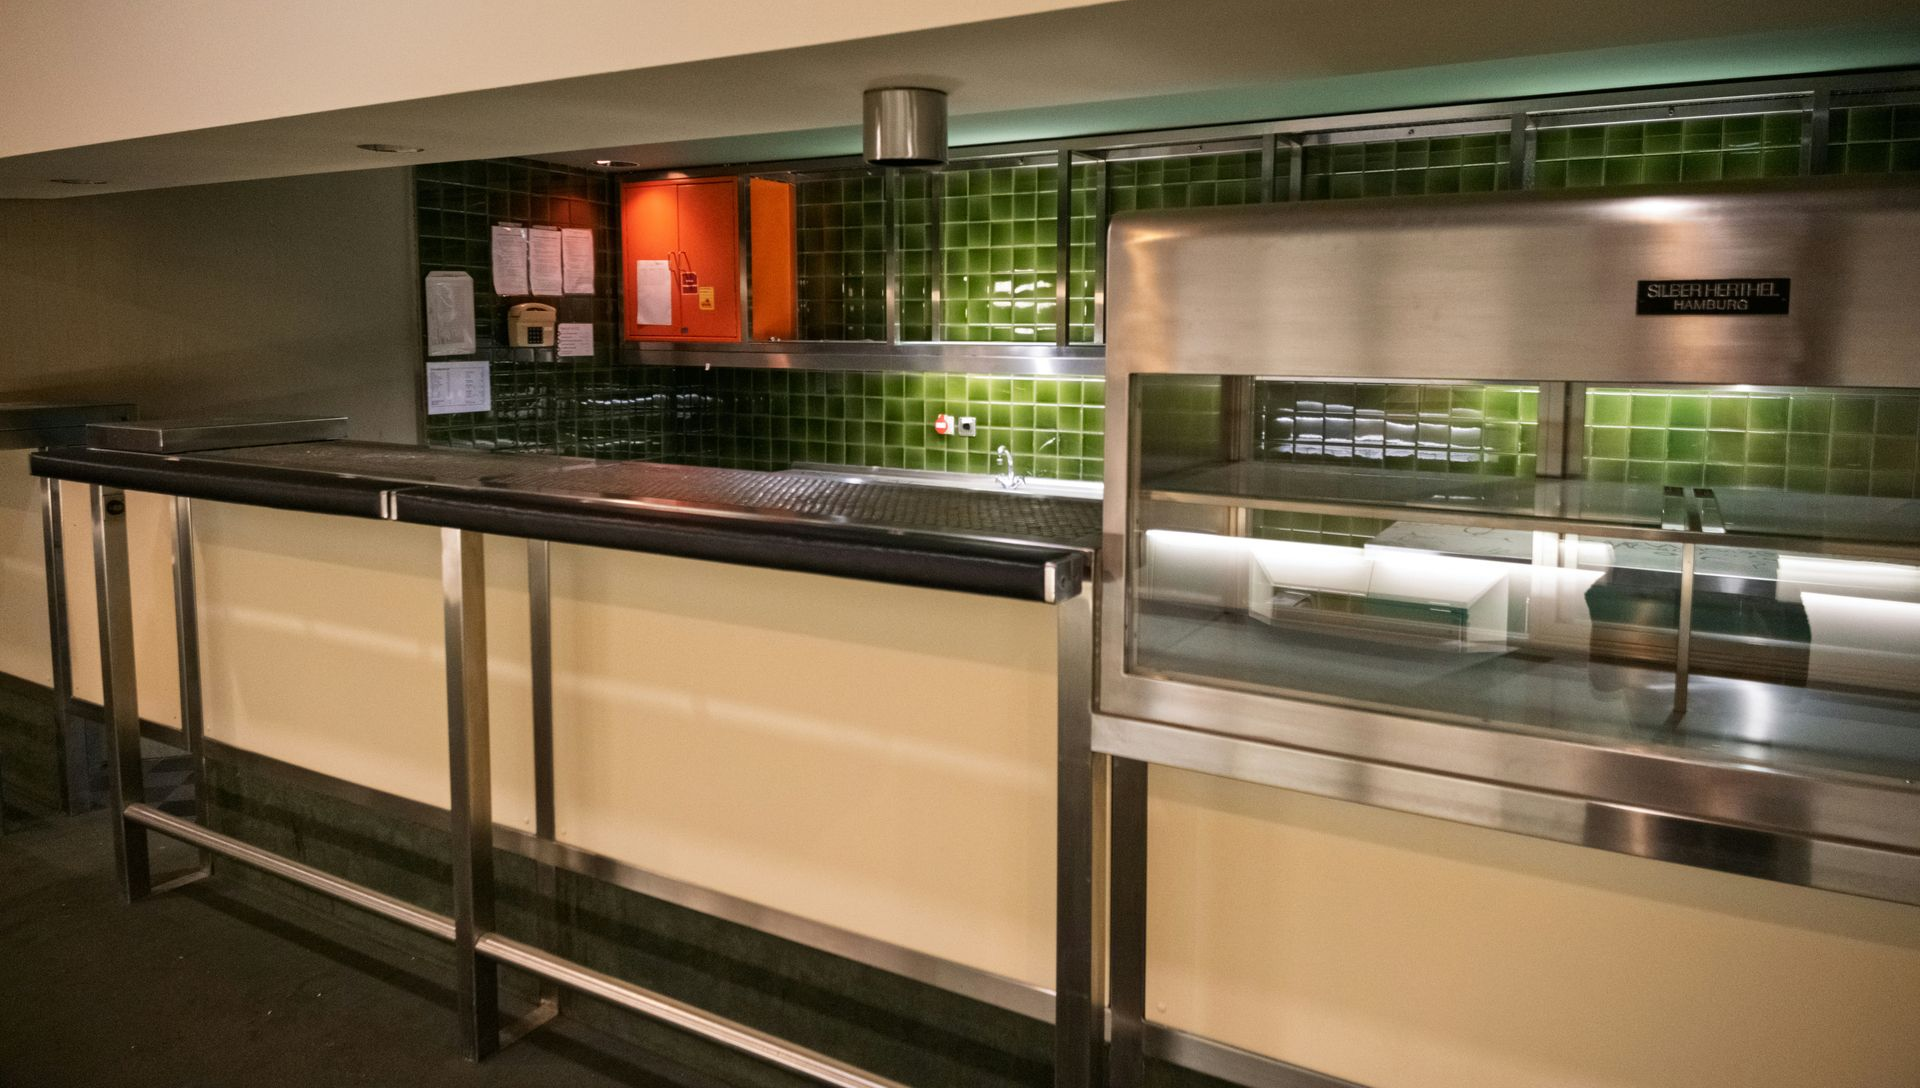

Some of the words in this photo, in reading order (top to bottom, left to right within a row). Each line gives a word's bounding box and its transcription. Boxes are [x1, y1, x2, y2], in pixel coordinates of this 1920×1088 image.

[1647, 283, 1702, 298] SILBER
[1705, 282, 1780, 297] HERTHEL
[1673, 299, 1748, 311] HAMBURG
